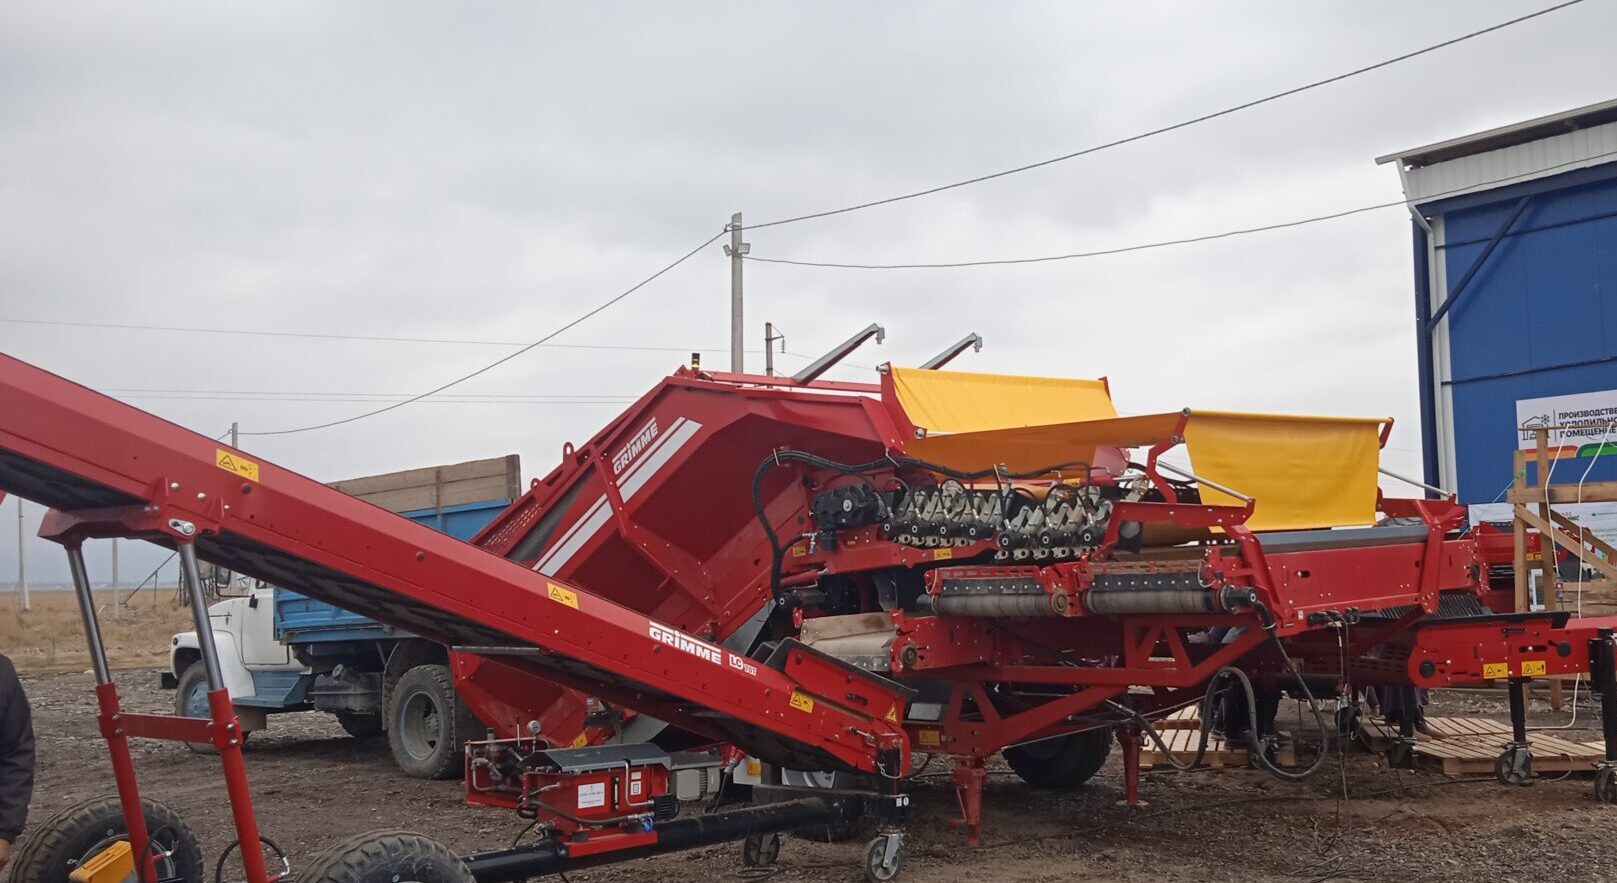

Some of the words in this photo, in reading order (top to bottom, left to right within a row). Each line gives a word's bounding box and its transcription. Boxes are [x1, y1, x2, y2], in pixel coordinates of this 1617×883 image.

[1558, 407, 1617, 420] ПРОИЗВОДСТВЕ
[612, 418, 659, 475] GRIMME
[649, 622, 722, 665] GRIMME
[729, 654, 743, 669] LC
